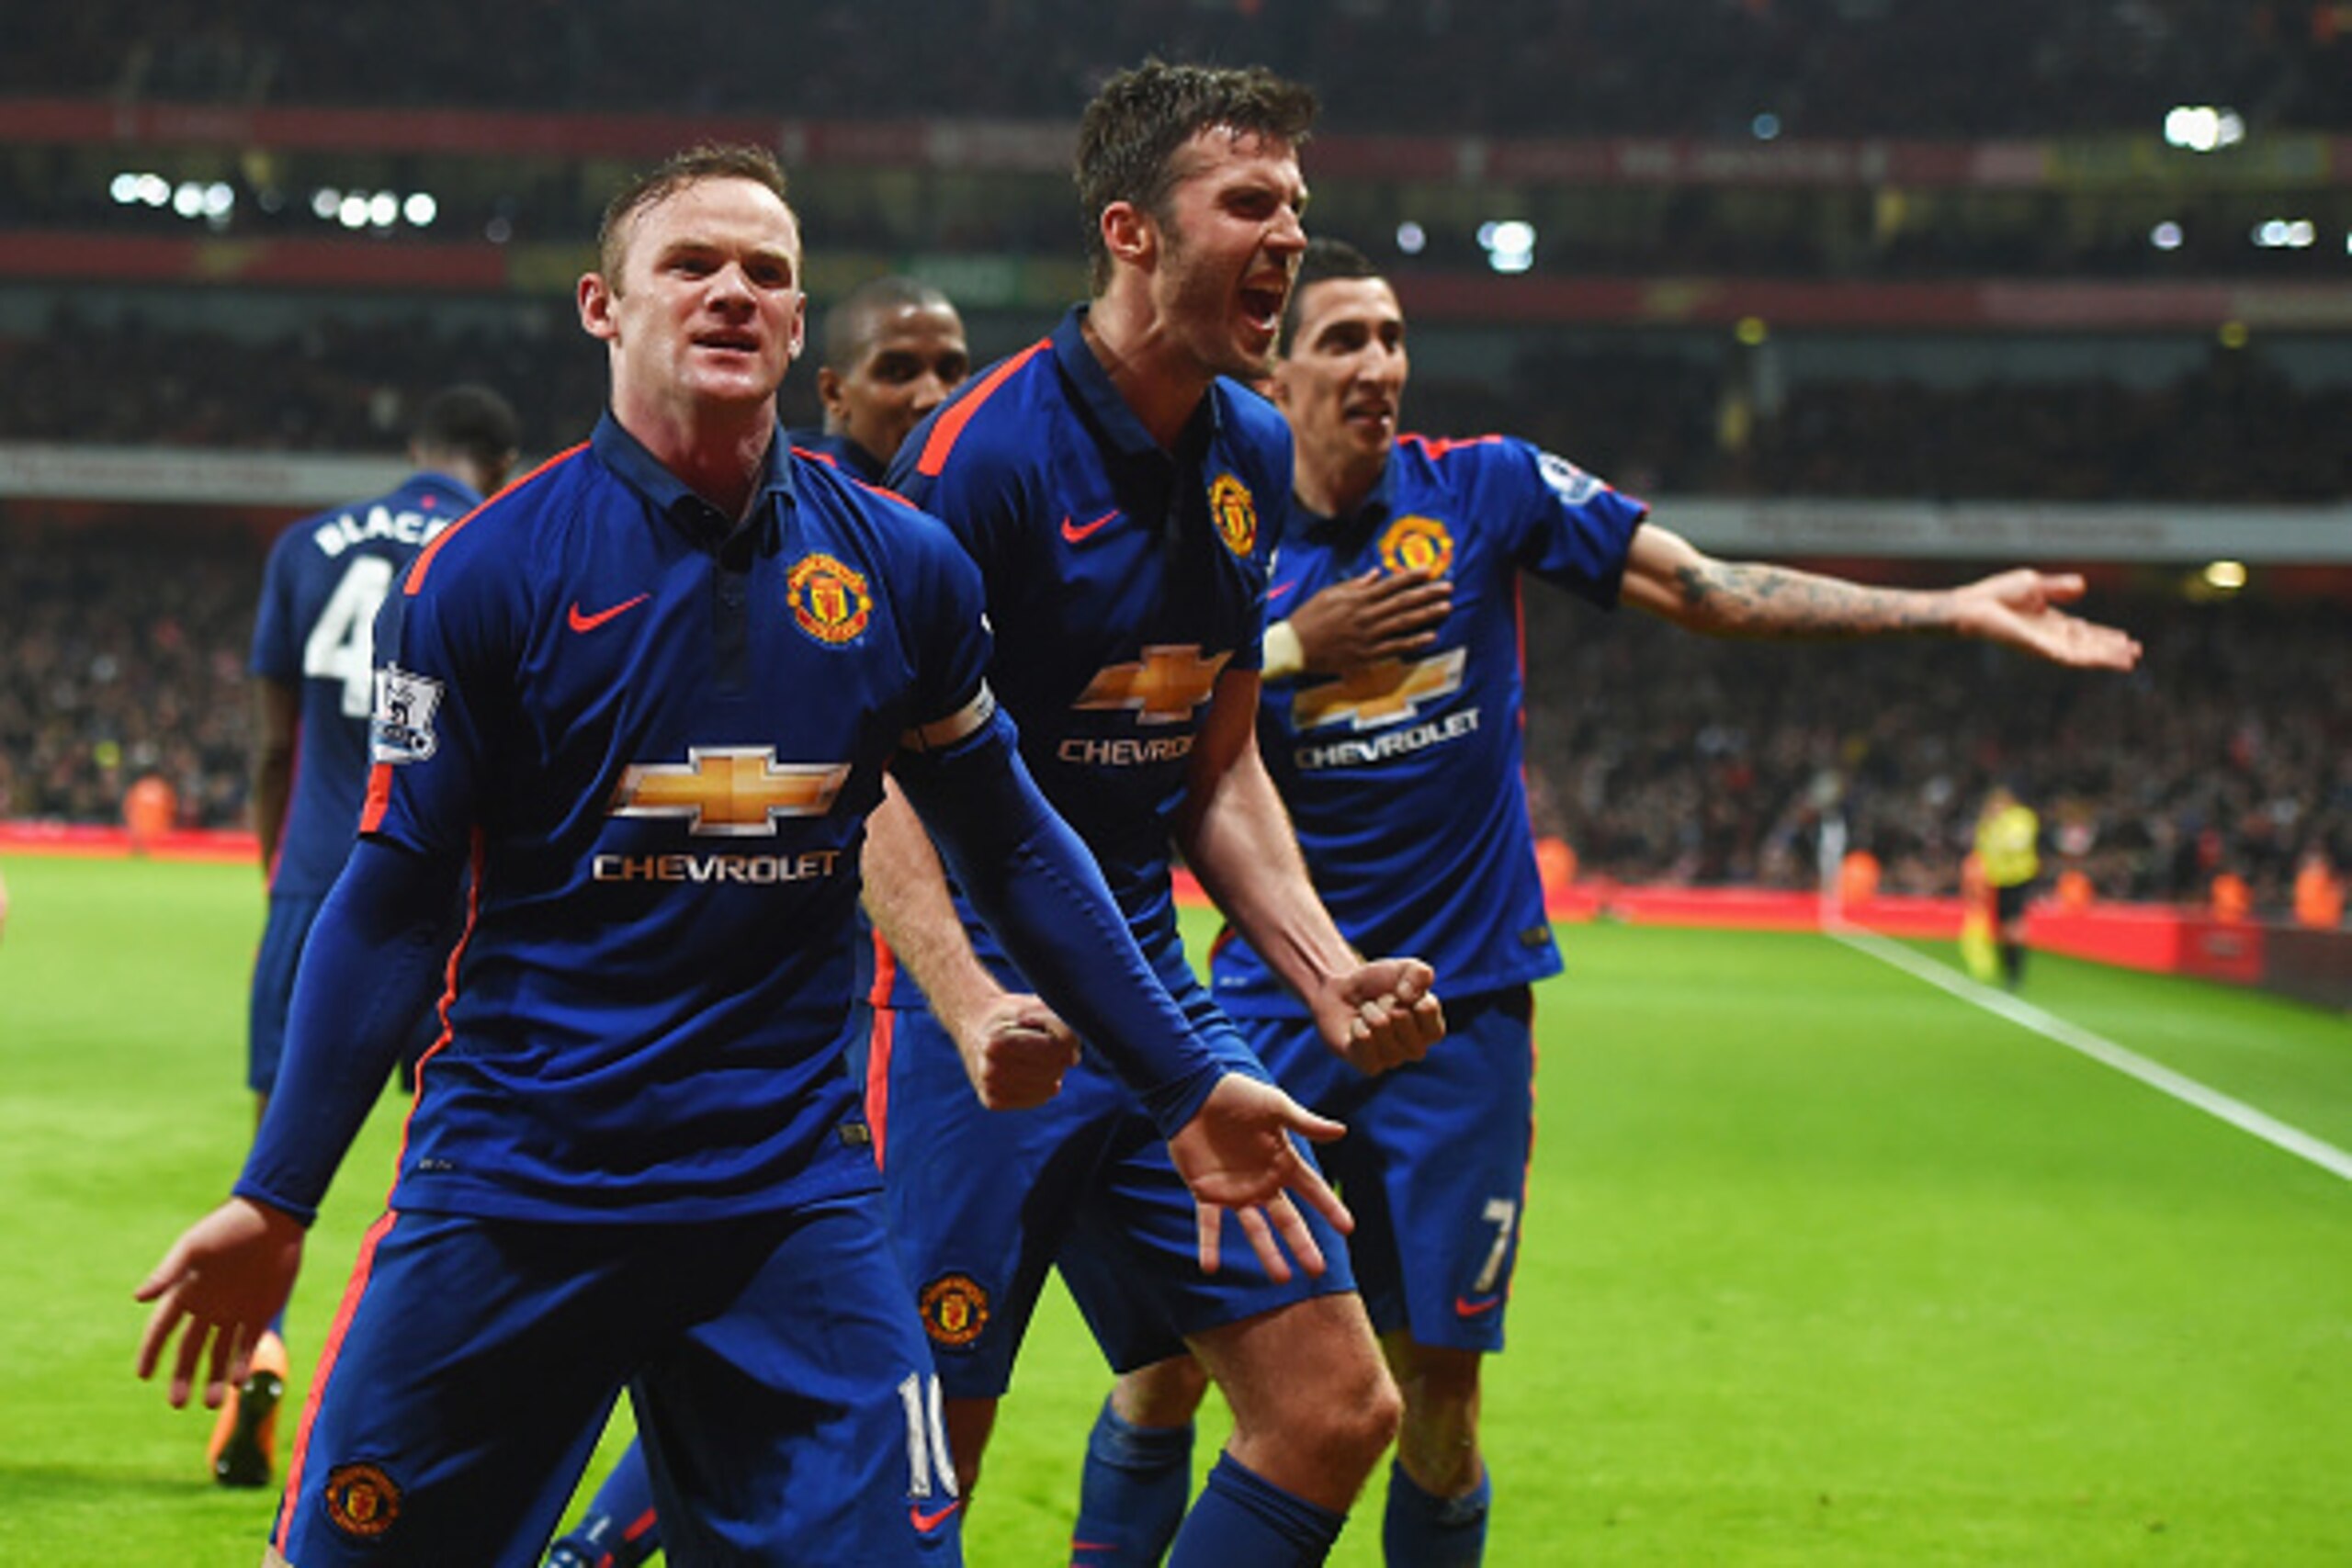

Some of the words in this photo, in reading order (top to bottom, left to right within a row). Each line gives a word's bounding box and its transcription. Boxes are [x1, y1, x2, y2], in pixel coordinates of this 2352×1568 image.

[304, 557, 392, 718] 4
[1295, 707, 1480, 769] CHEVROLET
[594, 850, 841, 884] CHEVROLET
[1474, 1198, 1515, 1292] 7
